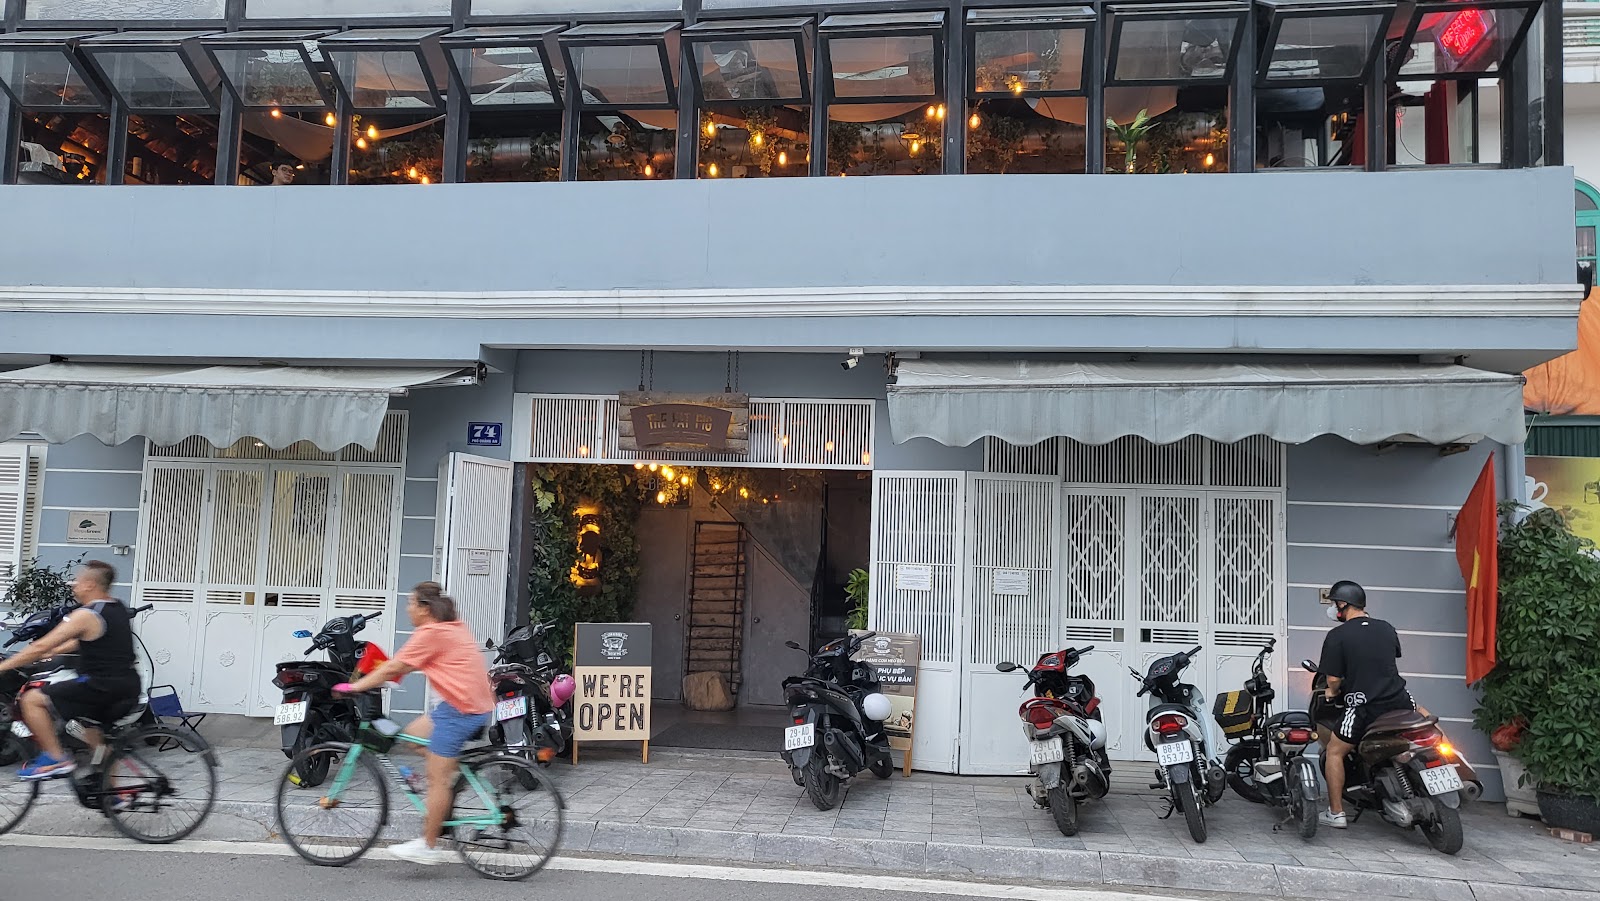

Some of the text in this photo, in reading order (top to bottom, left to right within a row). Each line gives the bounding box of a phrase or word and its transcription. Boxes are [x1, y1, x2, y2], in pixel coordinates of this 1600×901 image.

[646, 413, 667, 430] THE
[695, 413, 713, 432] PIG
[473, 425, 498, 438] 74
[877, 667, 891, 675] PHỤ
[897, 675, 912, 683] BÀN
[582, 674, 645, 698] WE'RE
[280, 703, 302, 714] 29-F1
[579, 702, 645, 731] OPEN
[787, 735, 812, 748] 048.49
[1033, 740, 1057, 752] 29-L1
[1032, 750, 1061, 763] 191.18
[1161, 751, 1190, 764] 353.73
[1425, 767, 1451, 781] 59-P1
[1428, 777, 1460, 793] 611.25
